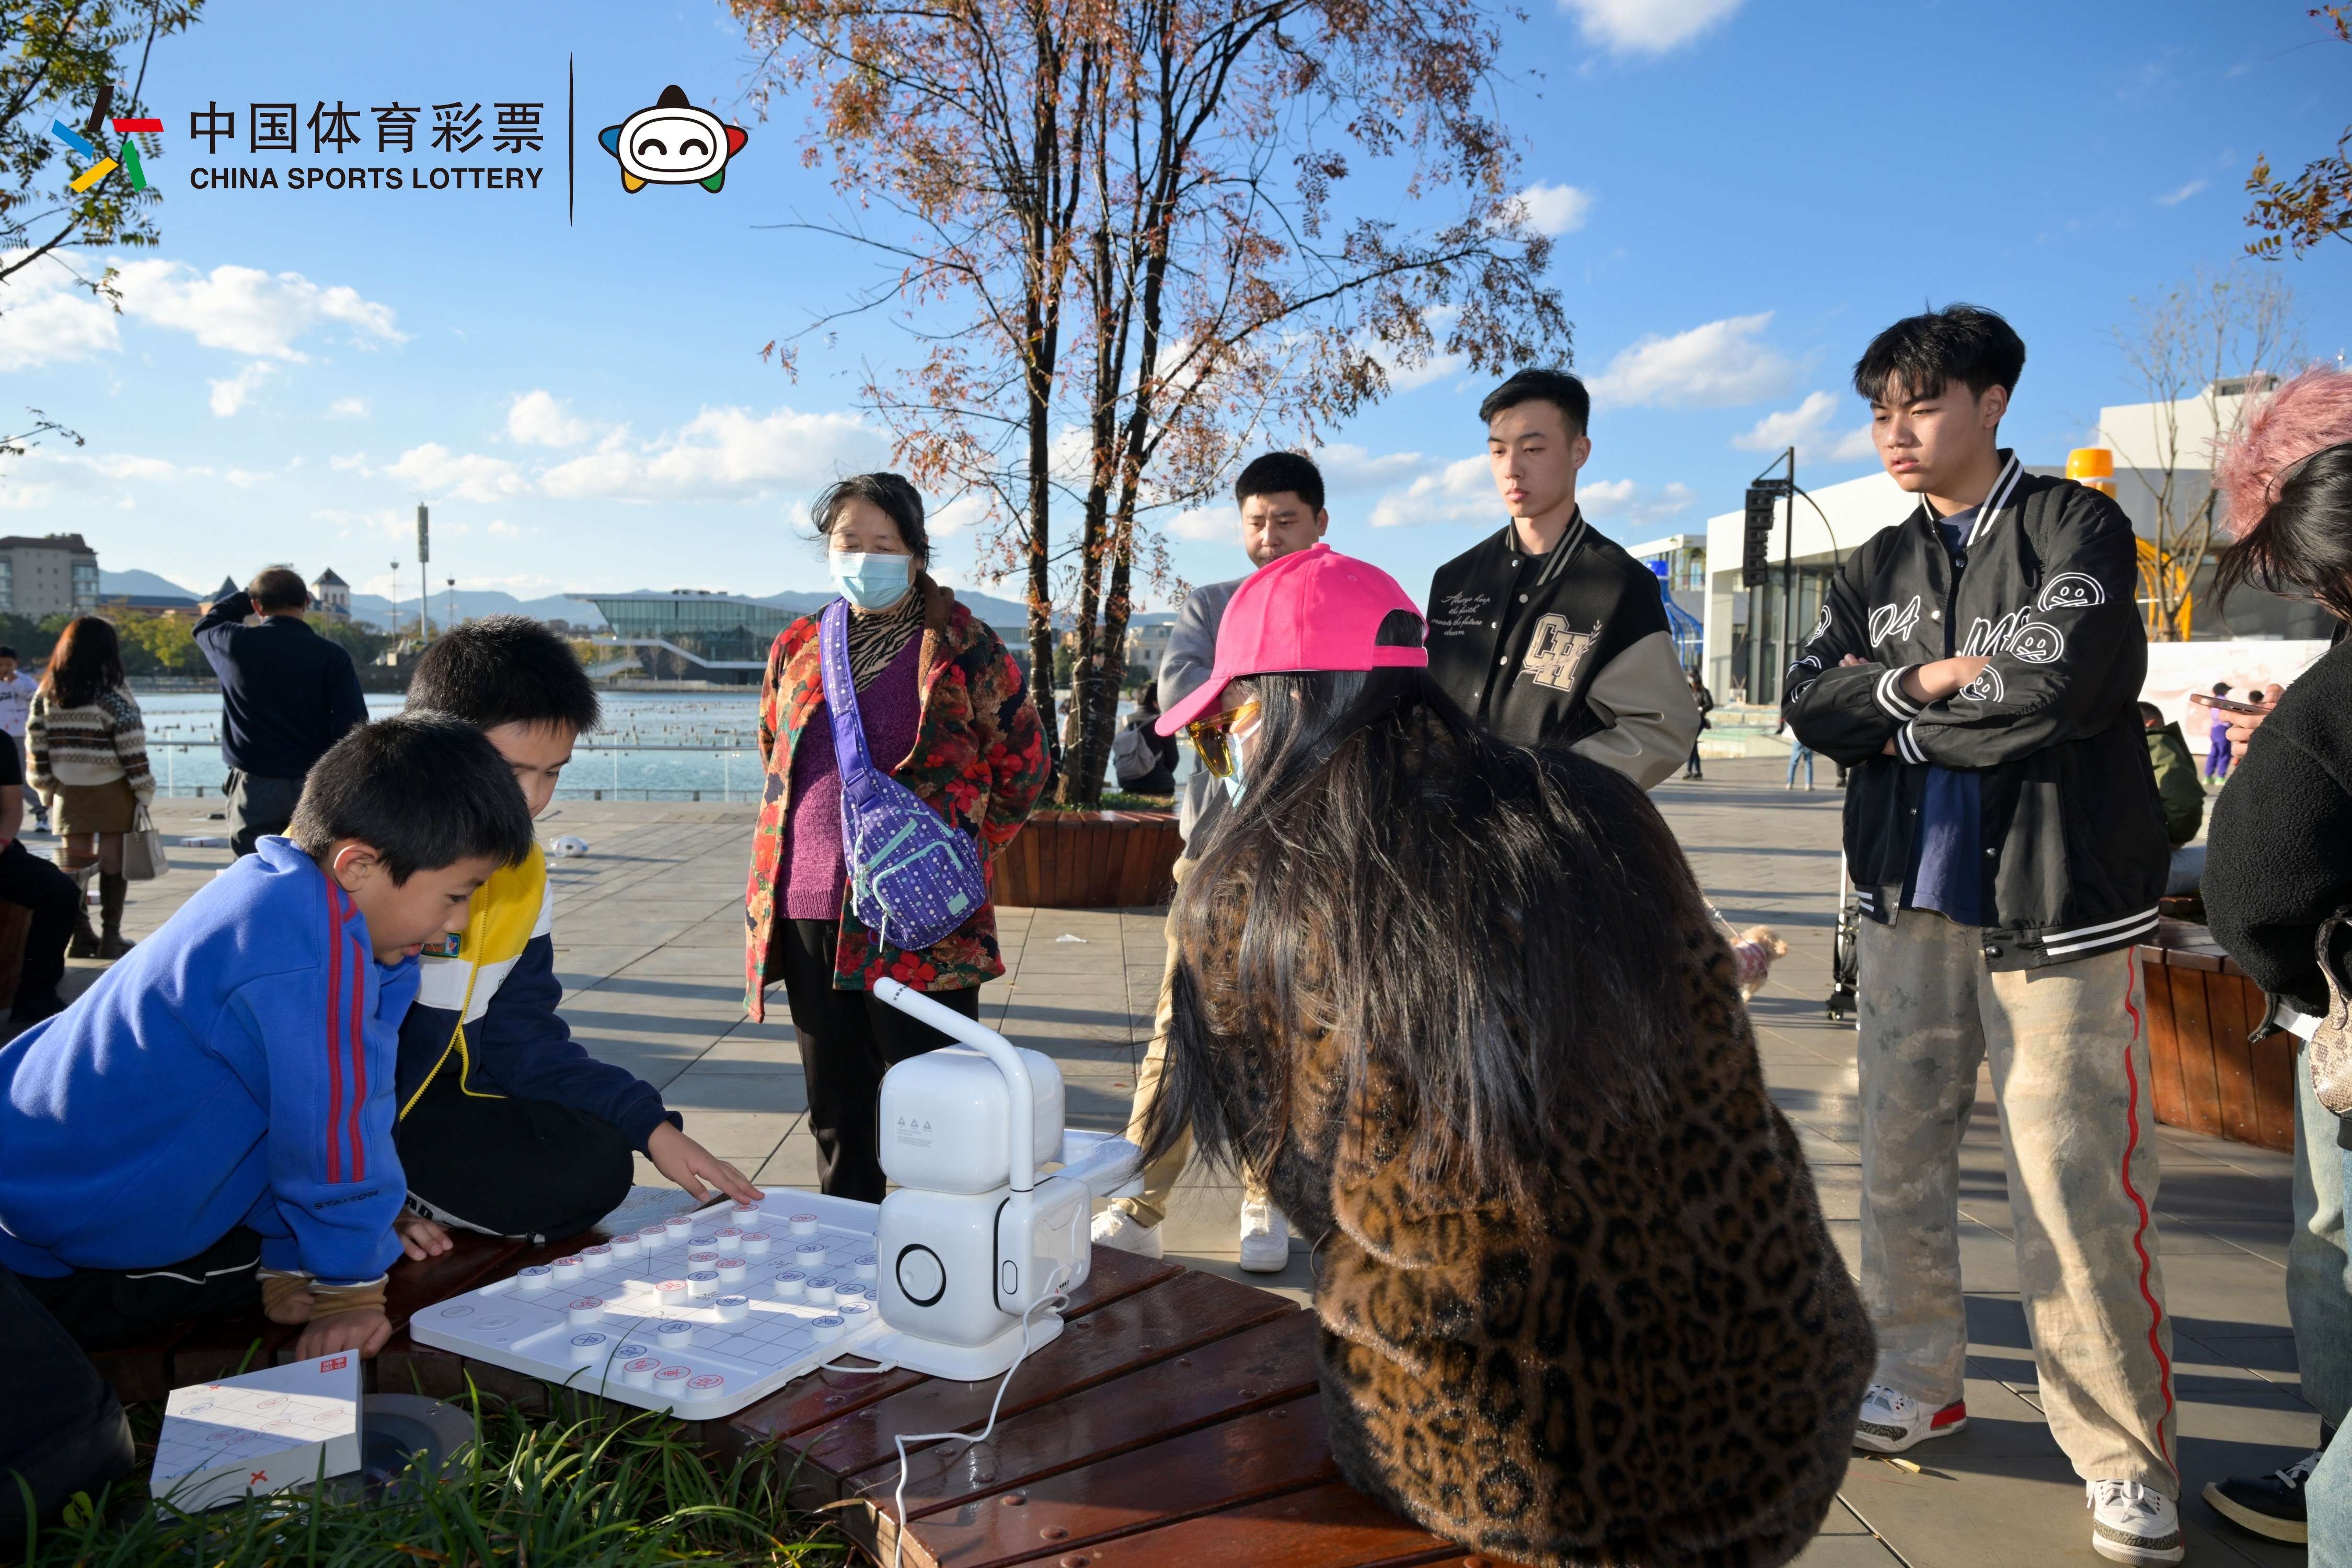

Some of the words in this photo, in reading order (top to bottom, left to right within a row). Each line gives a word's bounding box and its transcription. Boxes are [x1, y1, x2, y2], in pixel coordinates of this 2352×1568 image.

[1474, 594, 1491, 605] keep
[1457, 604, 1480, 617] faith
[1459, 615, 1483, 628] future
[1444, 627, 1465, 636] dream
